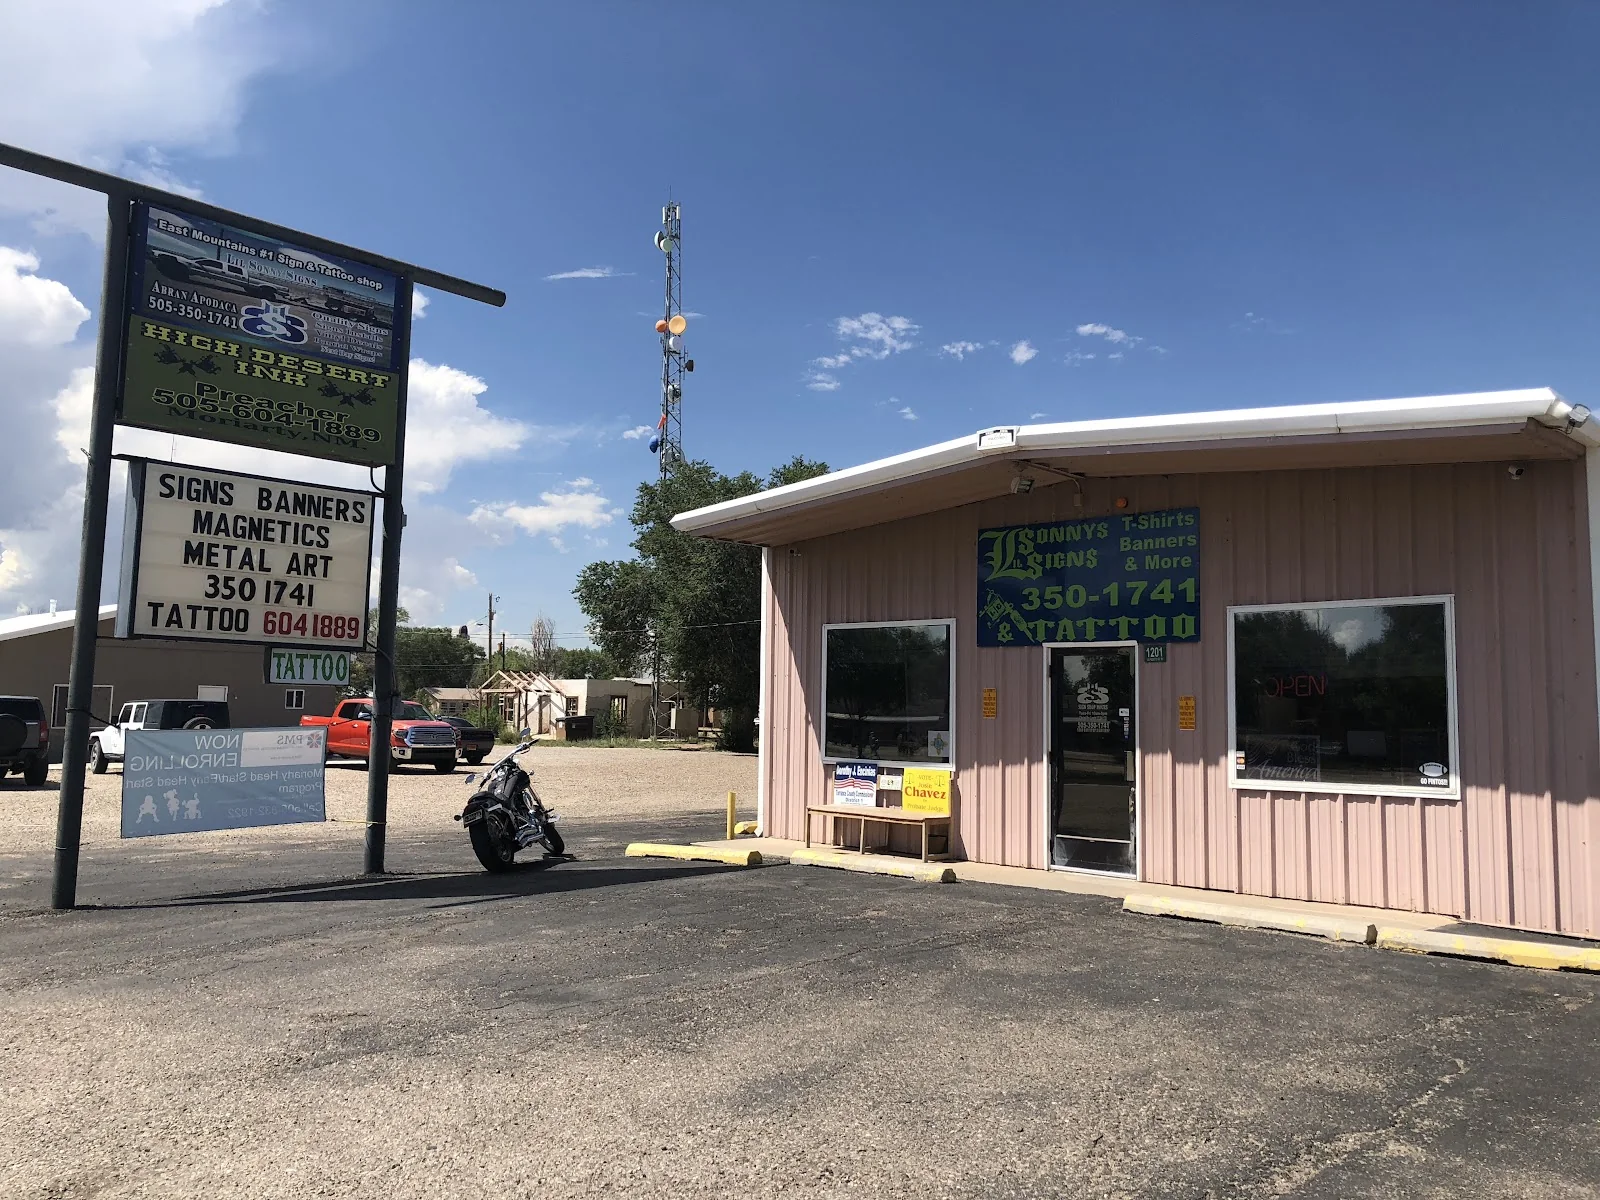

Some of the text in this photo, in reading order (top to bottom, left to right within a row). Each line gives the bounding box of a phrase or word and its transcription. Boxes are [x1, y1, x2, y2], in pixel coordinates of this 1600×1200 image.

[158, 218, 383, 291] East Mountains #1 Sign & Tattoo shop
[148, 296, 238, 330] 505-350-1741
[312, 312, 388, 336] Quality Signs
[142, 322, 392, 388] HIGH DESERT
[236, 360, 309, 388] INK
[152, 387, 382, 443] 505-604-1889
[195, 381, 350, 424] Preacher
[159, 473, 366, 524] SIGNS BANNERS
[192, 510, 330, 549] MAGNETICS
[1122, 512, 1194, 532] T-Shirts
[1120, 534, 1196, 552] Banners
[183, 540, 333, 578] METAL ART
[1124, 554, 1192, 572] & More
[204, 574, 314, 607] 350 1741
[1022, 578, 1196, 611] 350-1741
[148, 602, 249, 632] TATTOO
[997, 612, 1197, 643] & TATTOO
[272, 651, 348, 682] TATTOO
[1146, 646, 1163, 658] 1201
[1266, 672, 1326, 698] OPEN
[904, 786, 946, 800] Chavez
